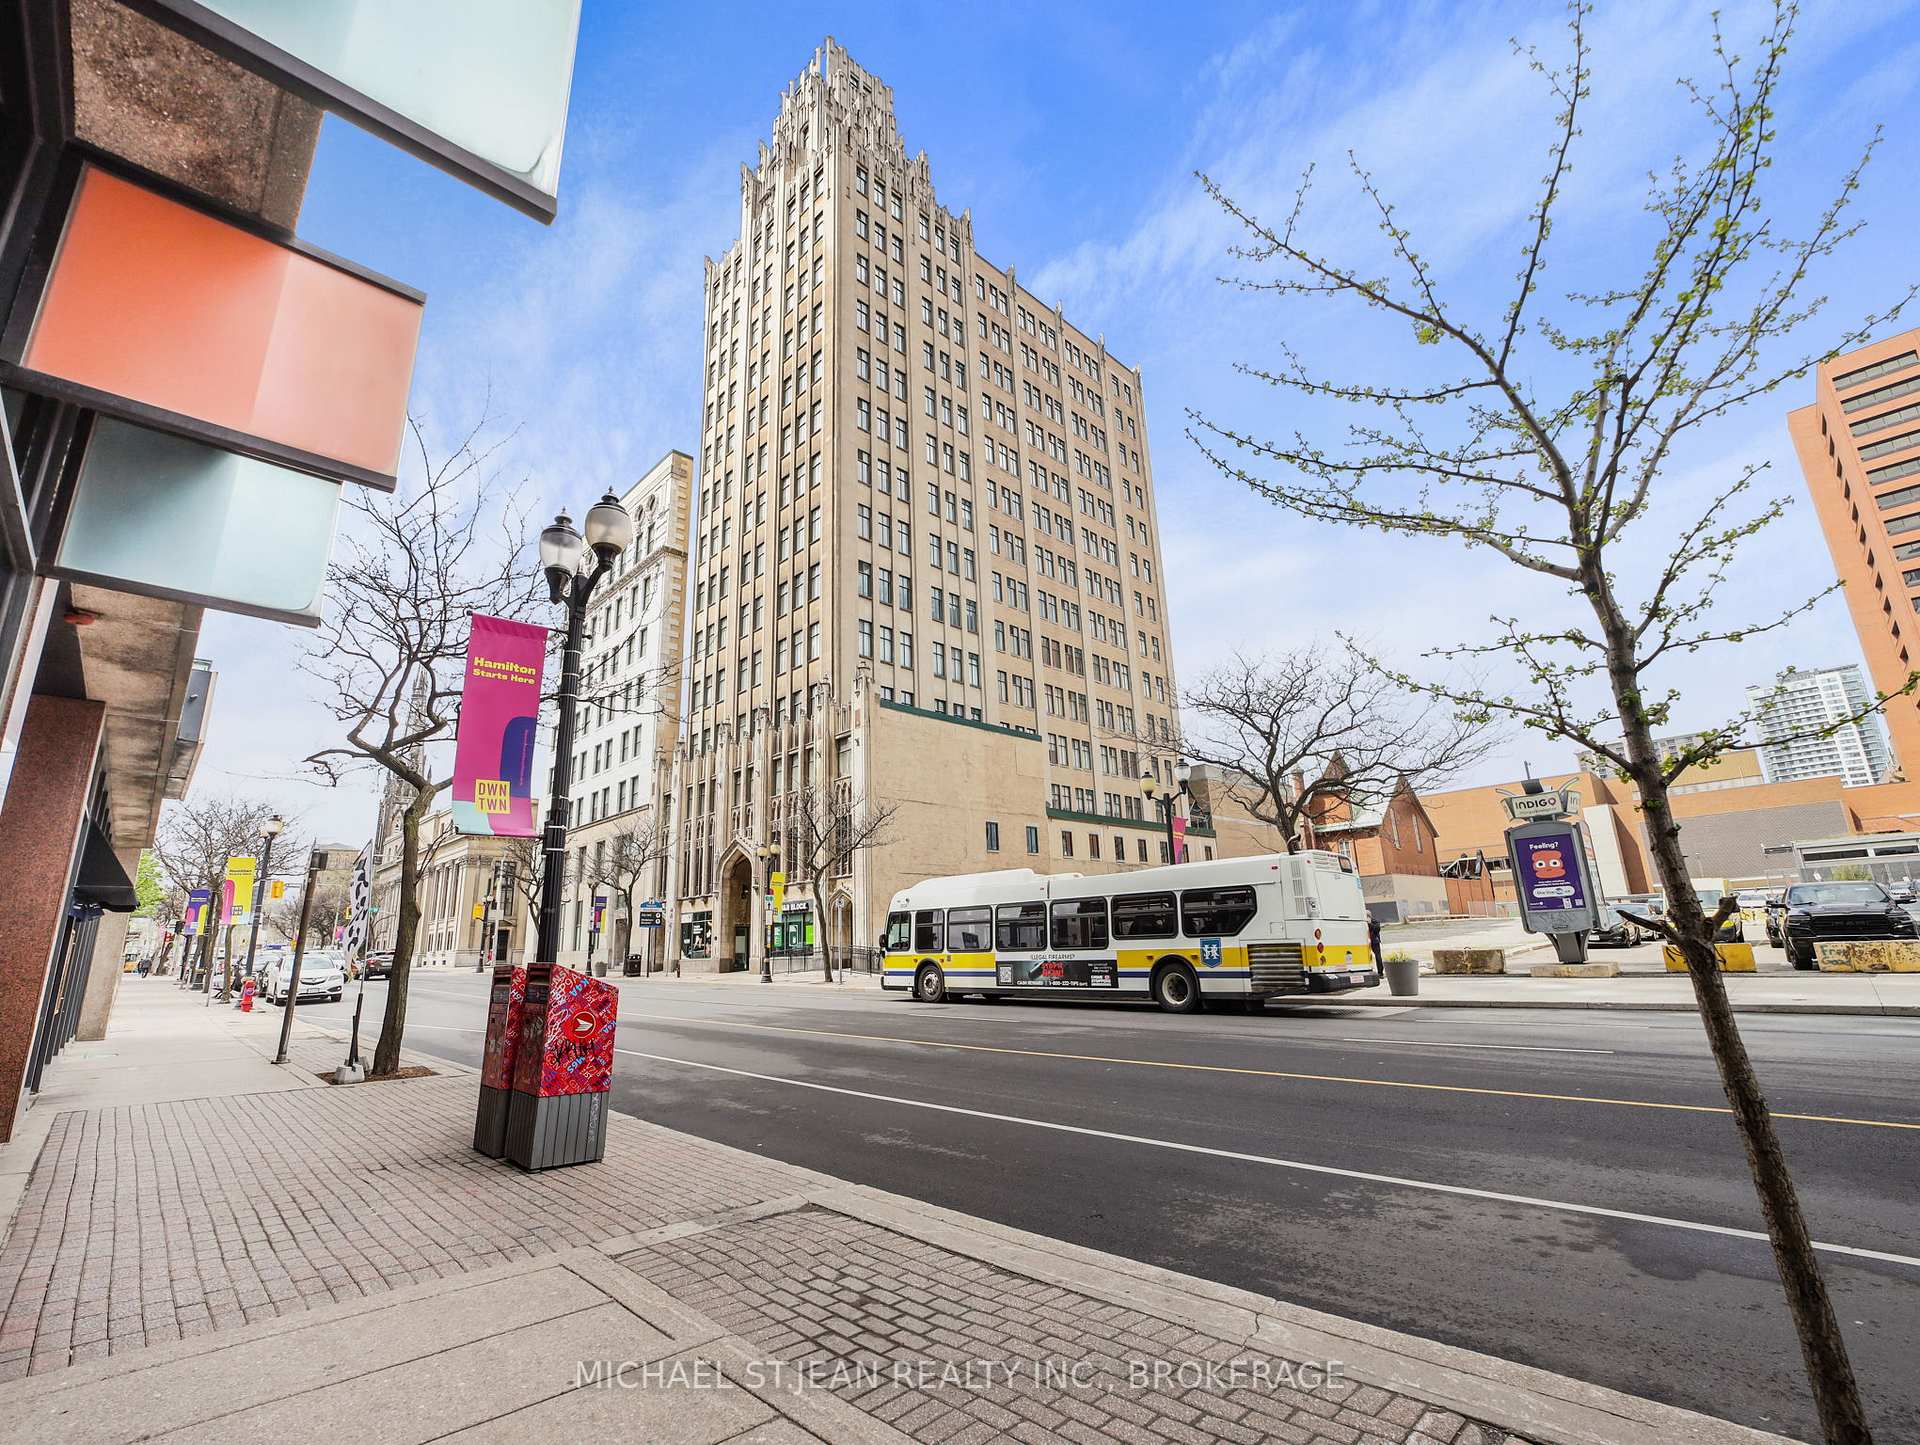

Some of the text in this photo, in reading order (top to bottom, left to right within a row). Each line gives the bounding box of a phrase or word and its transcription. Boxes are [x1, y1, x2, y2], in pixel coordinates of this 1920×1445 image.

[473, 656, 536, 675] Hamilton
[472, 668, 536, 685] Starts Here
[478, 783, 507, 797] DWN
[479, 798, 507, 811] TWN
[1515, 797, 1557, 809] INDIGO
[1529, 842, 1559, 850] Feeling?
[791, 902, 807, 911] BLOCK
